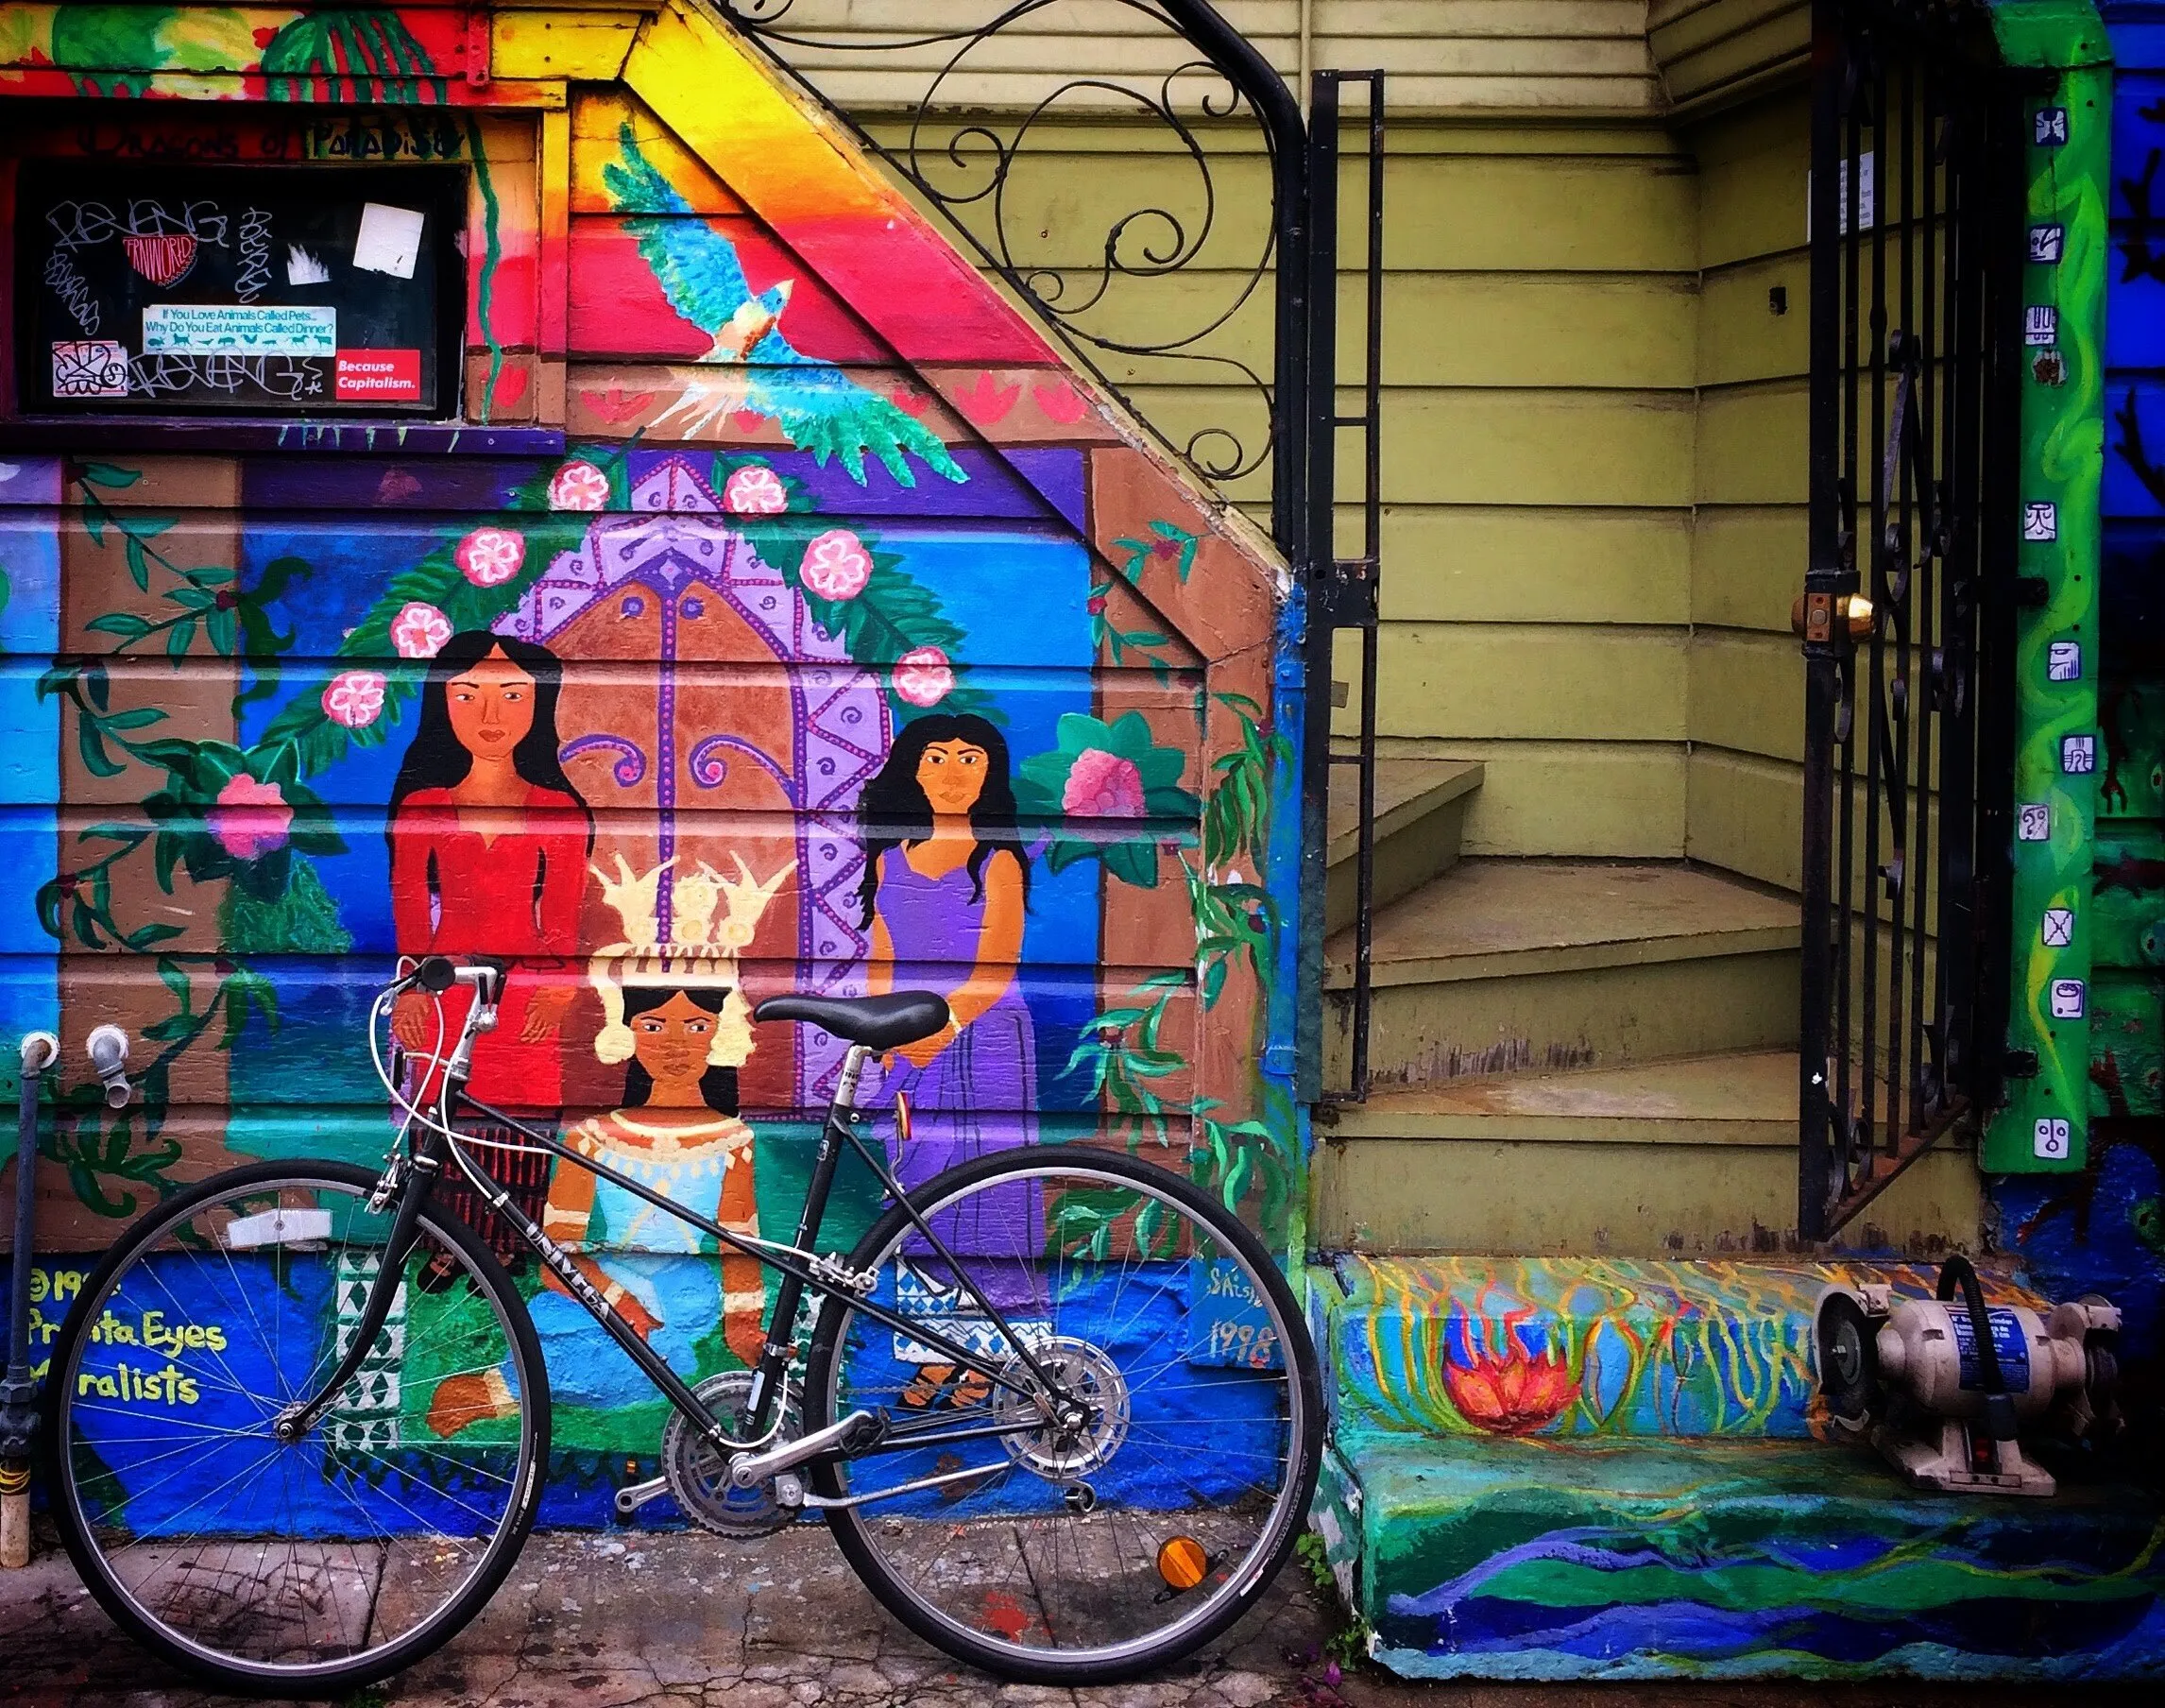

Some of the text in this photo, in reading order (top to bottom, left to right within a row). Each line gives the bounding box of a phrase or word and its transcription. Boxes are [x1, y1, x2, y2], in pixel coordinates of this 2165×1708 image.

[162, 309, 169, 319] If
[171, 309, 189, 319] You
[191, 310, 216, 320] Love
[217, 310, 256, 320] Animals
[257, 310, 288, 320] Called
[145, 321, 334, 334] Why Do You Eat Animals Called Dinner?
[338, 360, 395, 372] Because
[338, 376, 416, 392] Capitalism.
[525, 1221, 610, 1320] UNIVEGA
[28, 1307, 228, 1358] Prita Eyes
[1210, 1319, 1274, 1369] 1998
